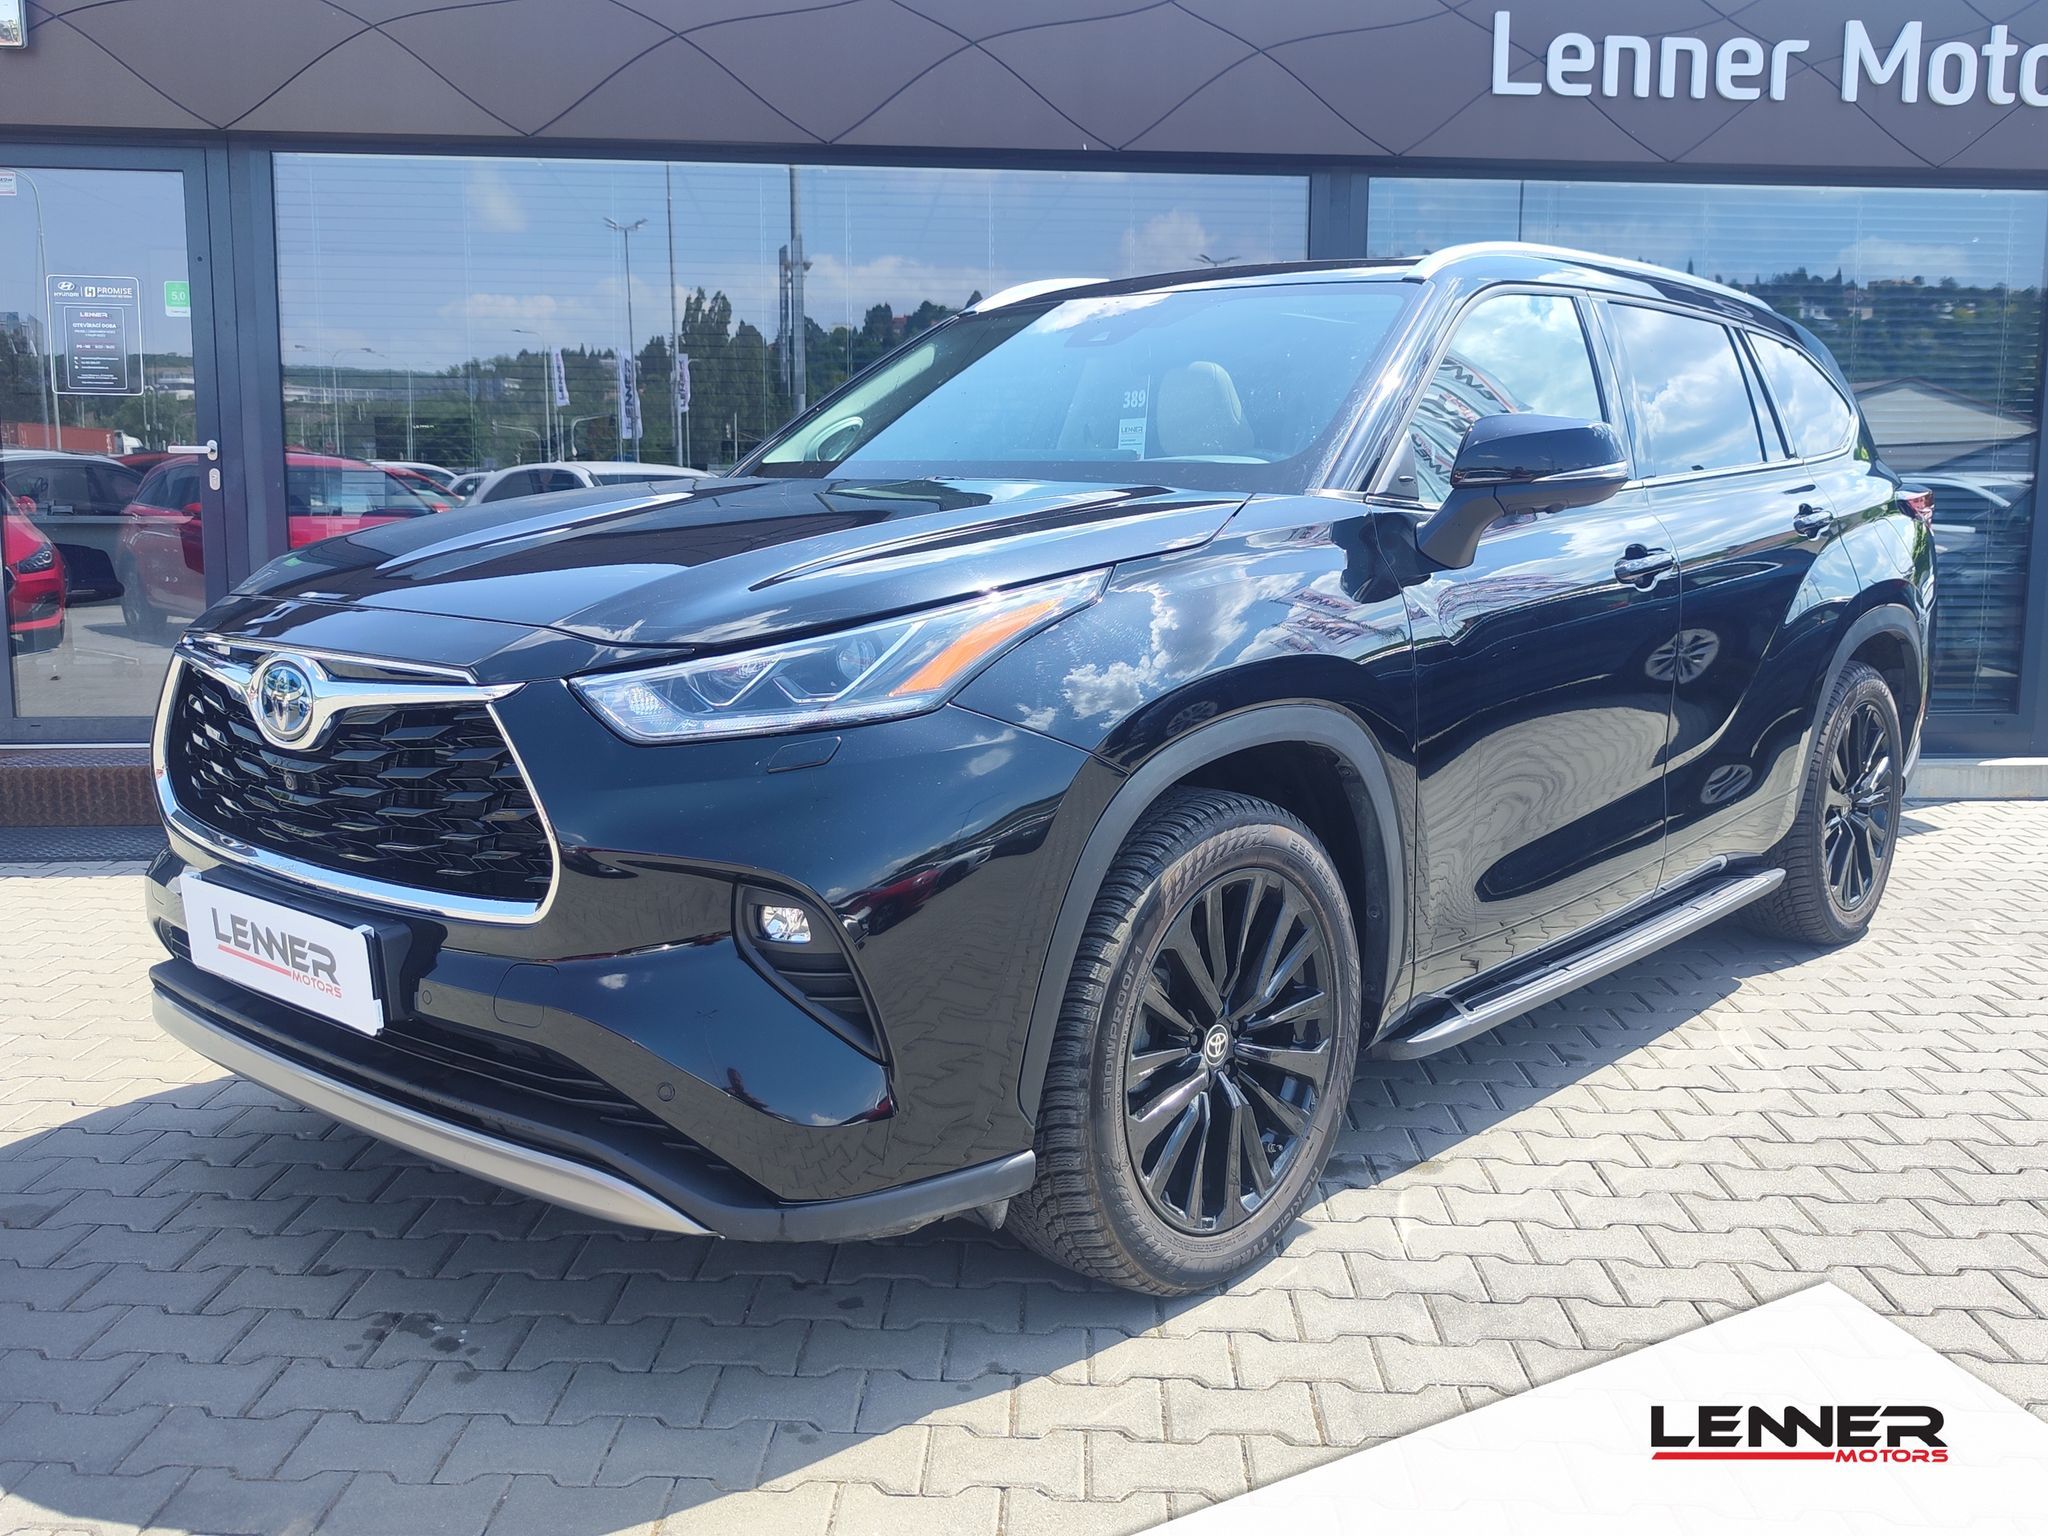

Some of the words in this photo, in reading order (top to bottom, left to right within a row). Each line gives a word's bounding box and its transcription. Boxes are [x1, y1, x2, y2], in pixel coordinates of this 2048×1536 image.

[1492, 10, 1810, 102] Lenner
[97, 287, 132, 295] PROMISE
[1122, 389, 1146, 409] 389
[210, 906, 342, 987] LENNER
[292, 968, 343, 999] MOTORS
